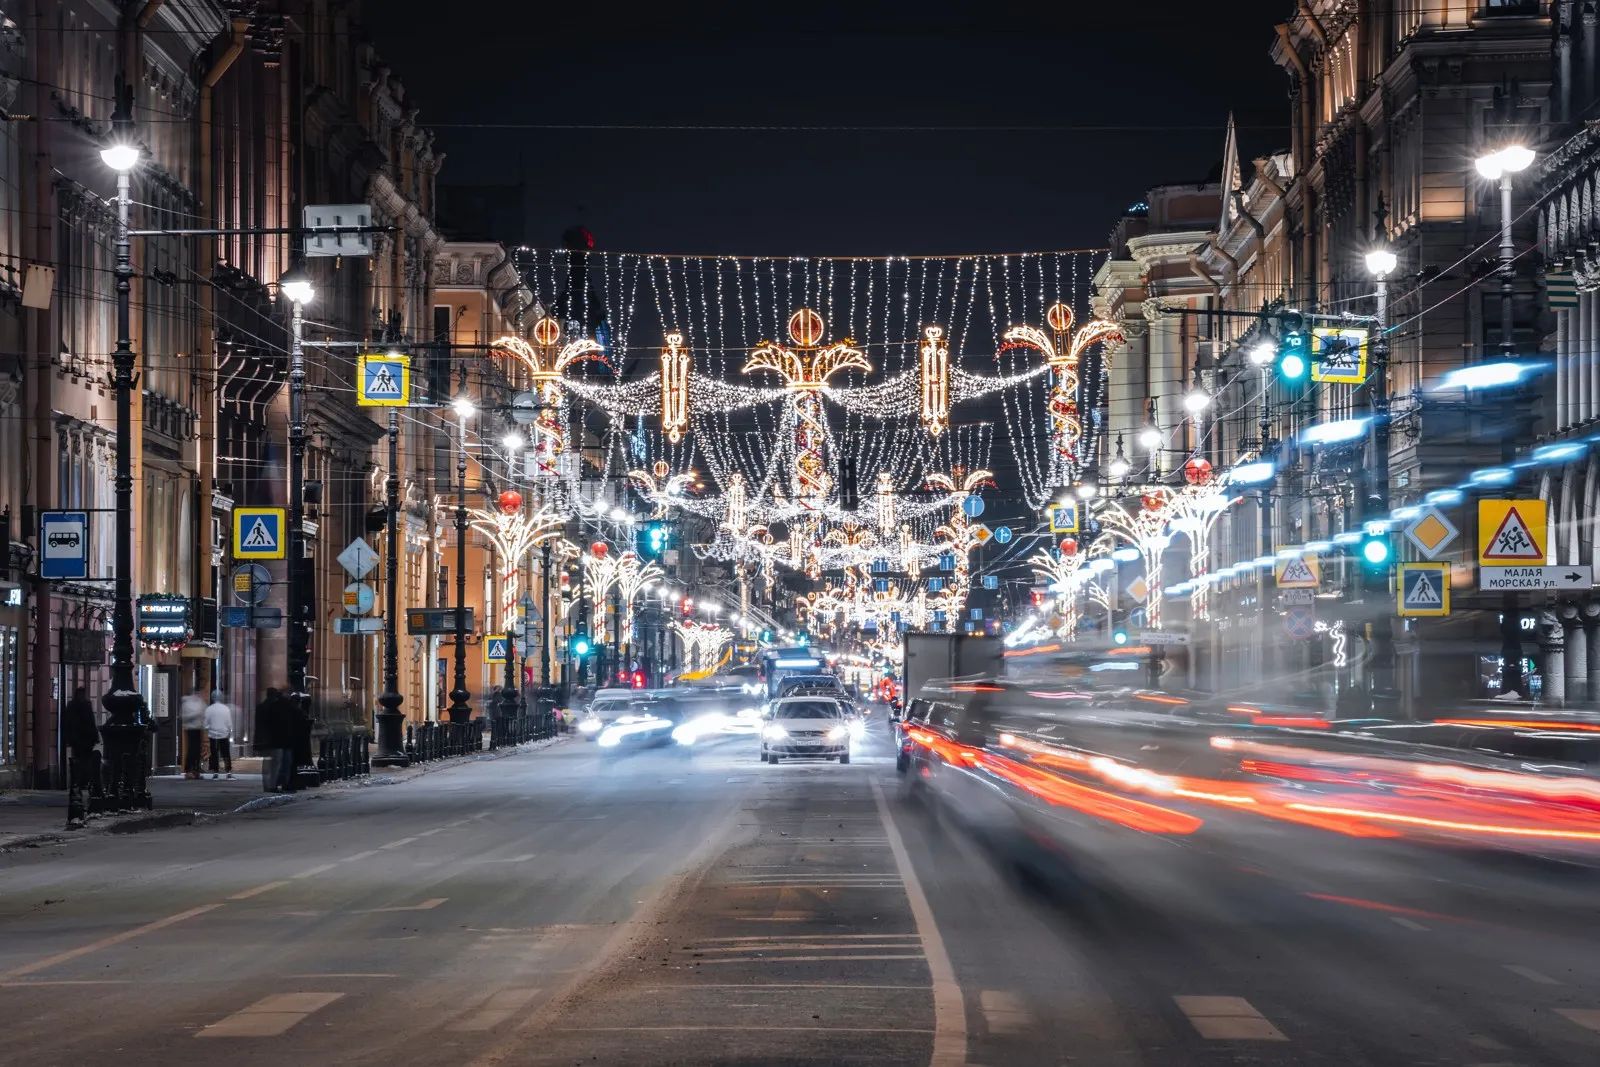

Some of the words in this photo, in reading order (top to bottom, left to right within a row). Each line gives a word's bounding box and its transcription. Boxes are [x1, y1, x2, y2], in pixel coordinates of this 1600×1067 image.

[1504, 568, 1543, 577] МАЛАЯ
[1489, 579, 1541, 588] МОРСКАЯ
[1543, 580, 1558, 589] ул.
